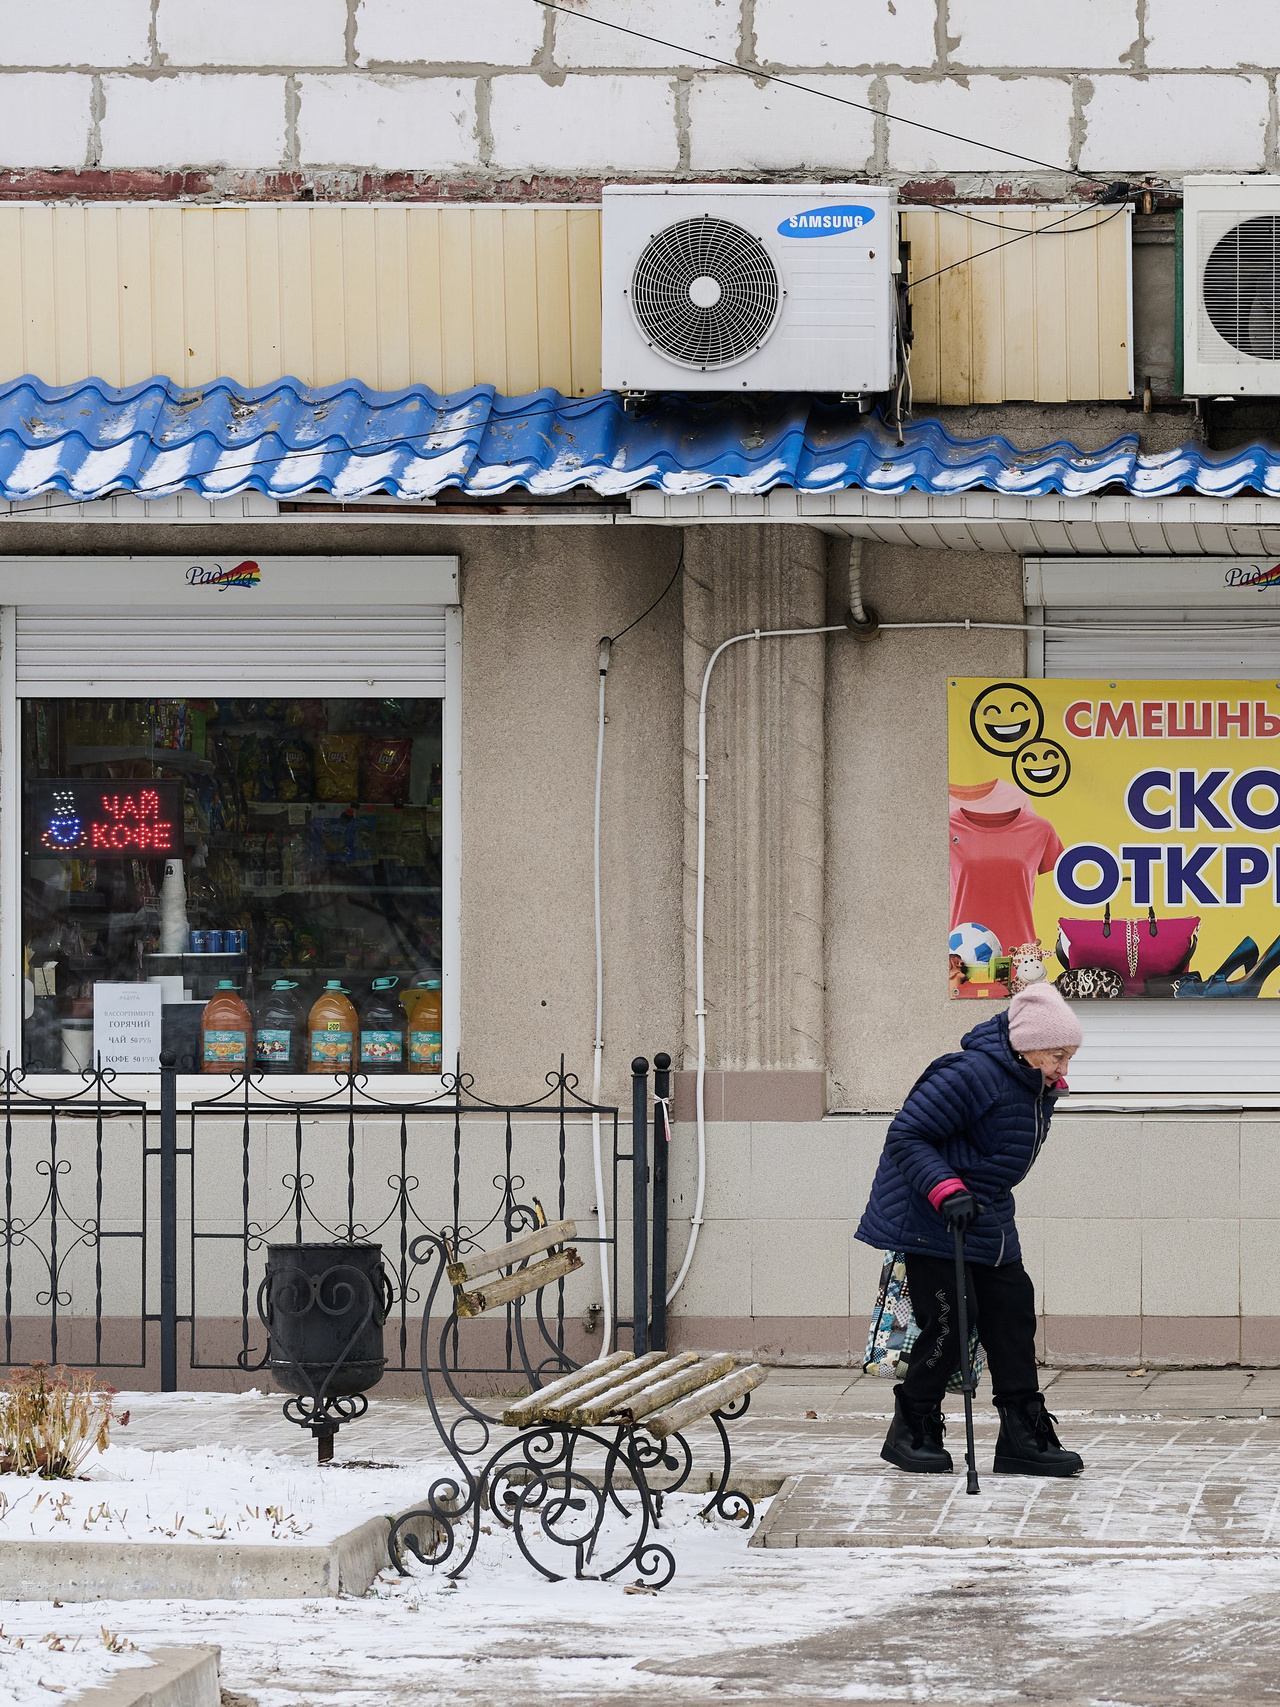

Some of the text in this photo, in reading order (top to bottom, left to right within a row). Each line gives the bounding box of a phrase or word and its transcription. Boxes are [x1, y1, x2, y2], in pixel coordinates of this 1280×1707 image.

[789, 215, 864, 228] SAMSUNG
[185, 563, 254, 592] Радуга
[101, 789, 160, 820] ЧАЙ
[91, 822, 172, 849] КОФЕ
[109, 1019, 151, 1028] ГОРЯЧИЙ
[108, 1035, 127, 1044] ЧАЙ
[105, 1055, 129, 1063] КОФЕ
